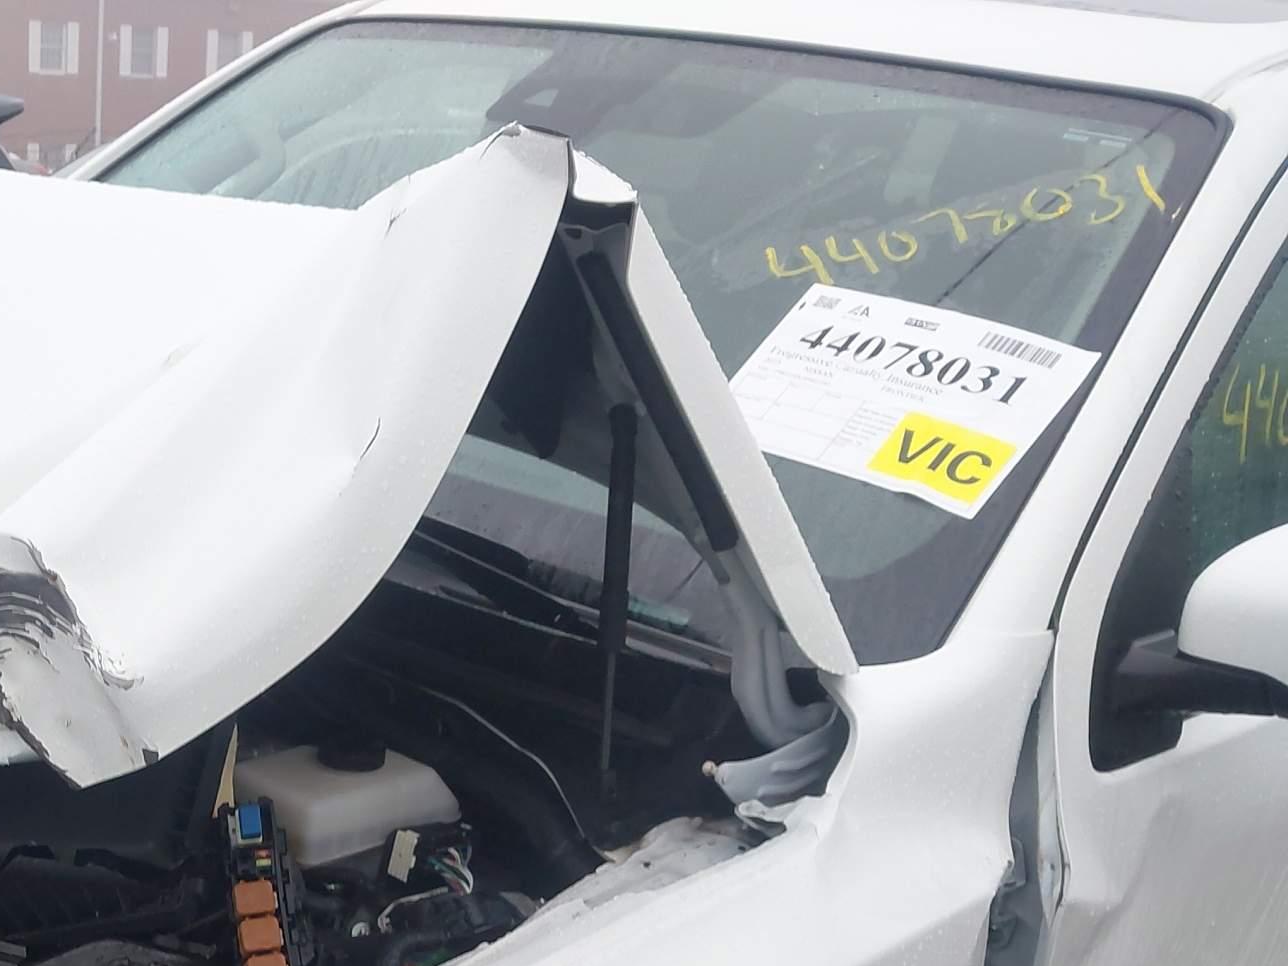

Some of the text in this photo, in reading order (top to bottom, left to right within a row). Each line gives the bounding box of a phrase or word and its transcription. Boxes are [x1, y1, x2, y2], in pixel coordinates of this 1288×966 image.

[765, 165, 1166, 285] 44078031
[799, 325, 1028, 407] 44078031
[896, 428, 993, 486] VIC
